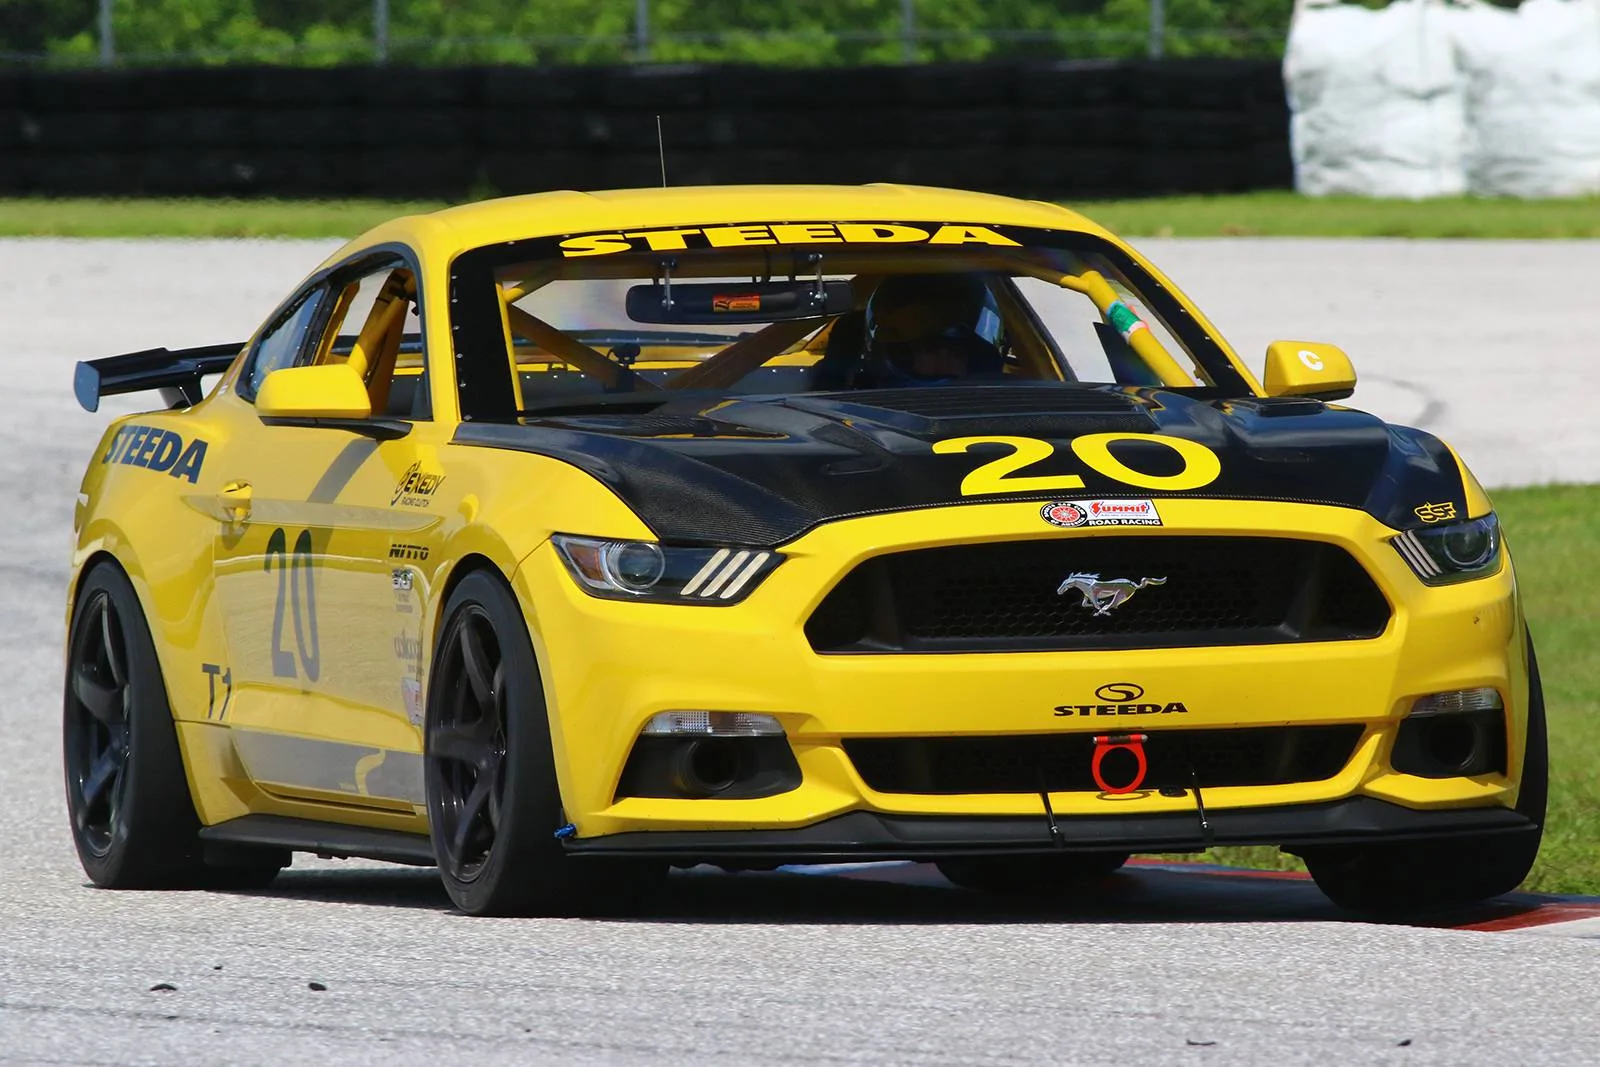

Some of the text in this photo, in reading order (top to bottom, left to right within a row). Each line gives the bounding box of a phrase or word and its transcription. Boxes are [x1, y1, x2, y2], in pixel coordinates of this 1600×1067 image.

[559, 223, 1024, 258] STEEDA
[1298, 349, 1324, 371] C
[102, 424, 209, 485] STEEDA
[931, 431, 1222, 497] 20
[403, 472, 447, 496] EXEDY
[1121, 518, 1161, 526] RACING
[389, 543, 430, 561] NITTO
[263, 527, 320, 683] 20
[201, 663, 232, 721] T1
[1053, 702, 1189, 717] STEEDA
